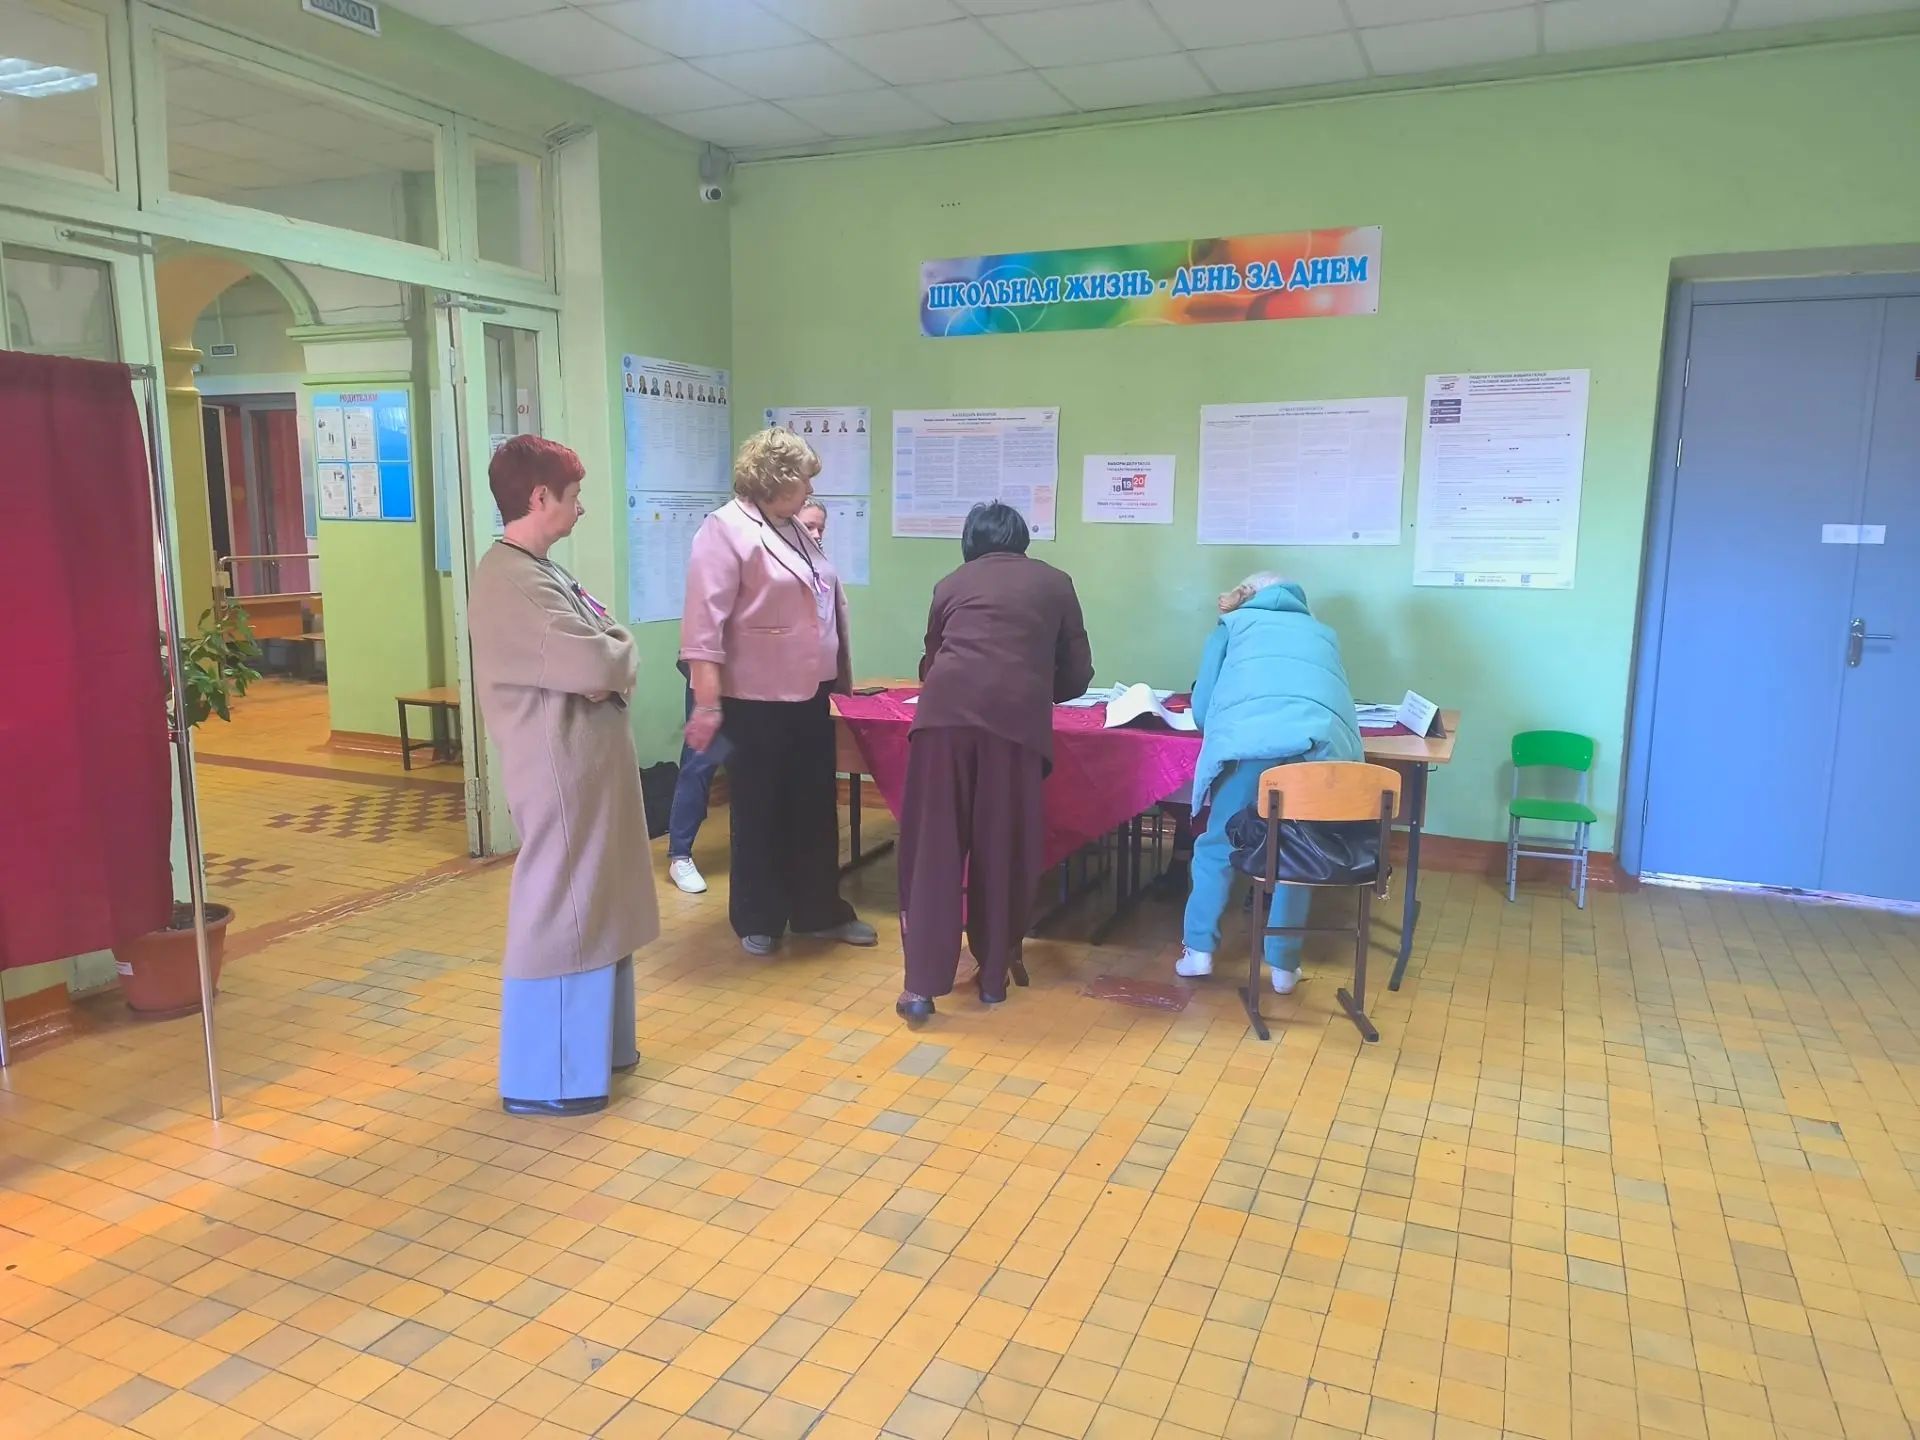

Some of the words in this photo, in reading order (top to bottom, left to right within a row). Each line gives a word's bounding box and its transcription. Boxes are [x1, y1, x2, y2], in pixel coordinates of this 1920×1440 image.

[929, 277, 1059, 308] ШКОЛЬНАЯ
[1064, 271, 1154, 300] ЖИЗНЬ
[1159, 281, 1167, 289] -
[1172, 266, 1241, 297] ДЕНЬ
[1246, 262, 1284, 289] ЗА
[1288, 256, 1369, 291] ДНЕМ
[1133, 477, 1144, 485] 20
